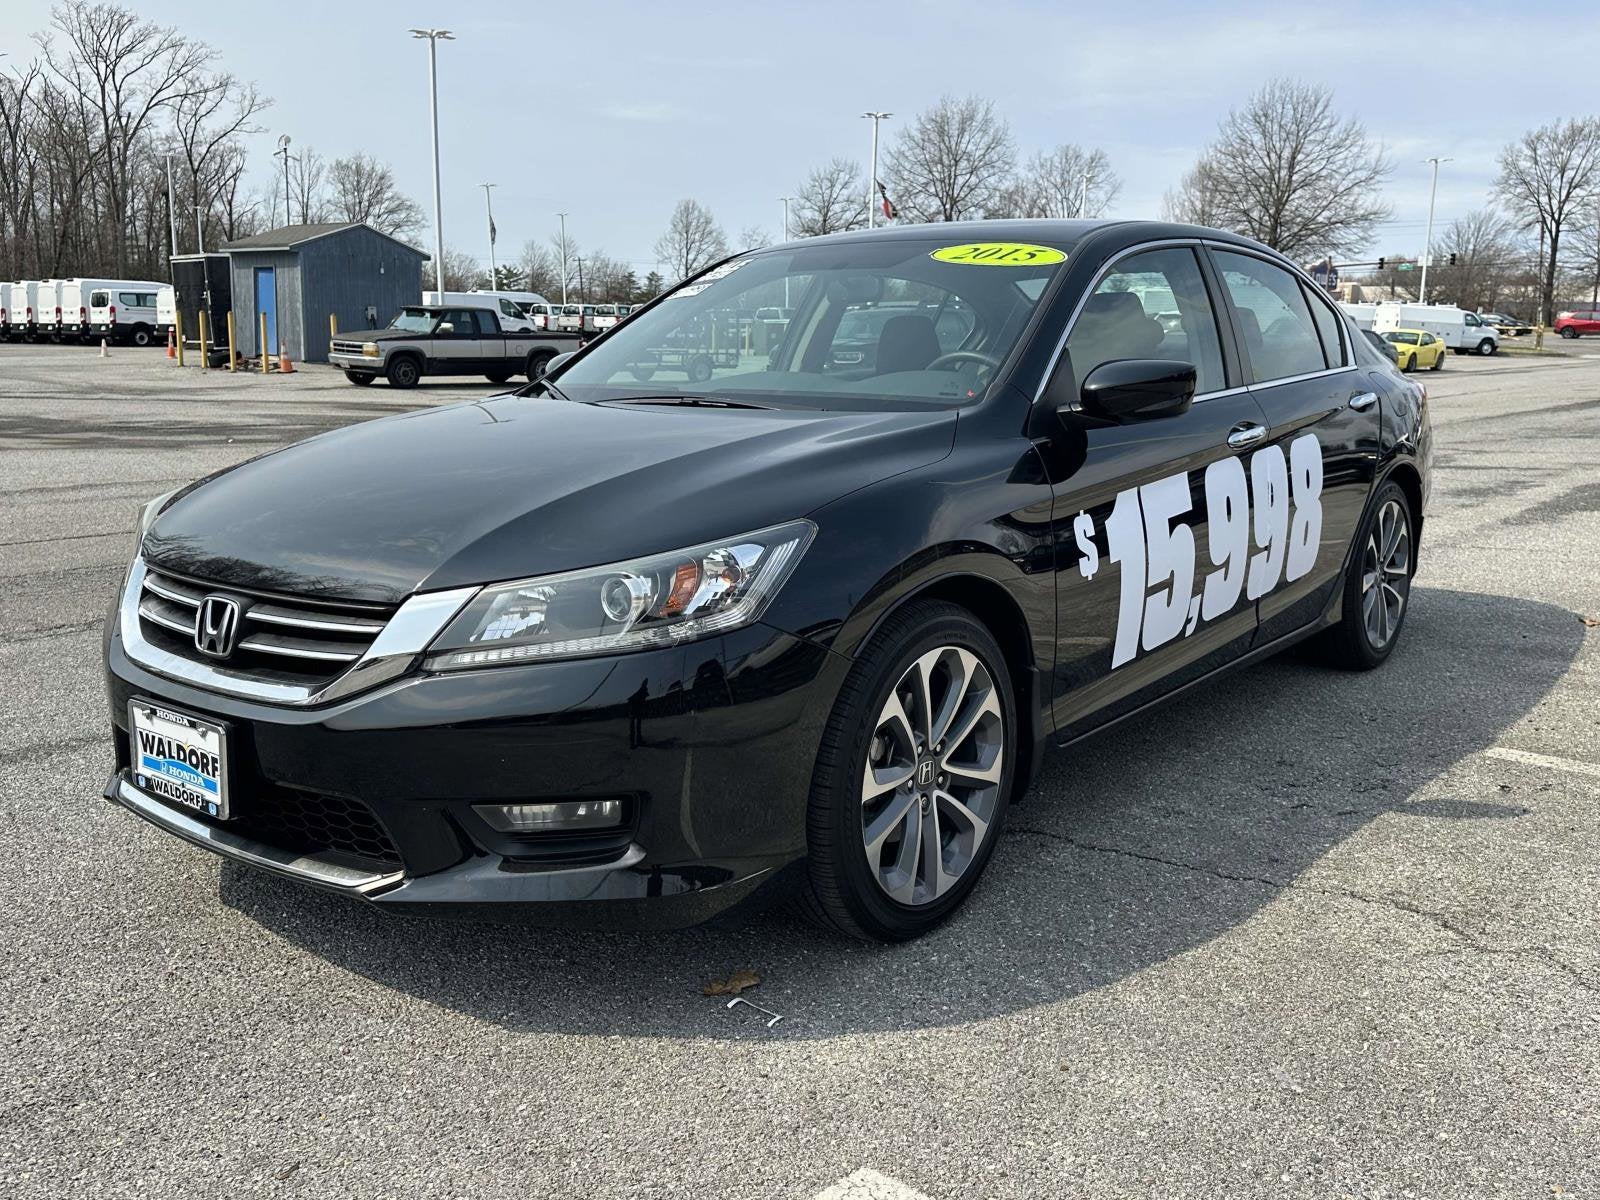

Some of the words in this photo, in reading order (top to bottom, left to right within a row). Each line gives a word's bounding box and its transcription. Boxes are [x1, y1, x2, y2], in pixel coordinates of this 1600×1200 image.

[946, 247, 1049, 262] 2015
[155, 708, 191, 727] HONDA
[139, 730, 220, 779] WALDORF
[168, 765, 206, 787] HONDA
[151, 777, 202, 810] WALDORF
